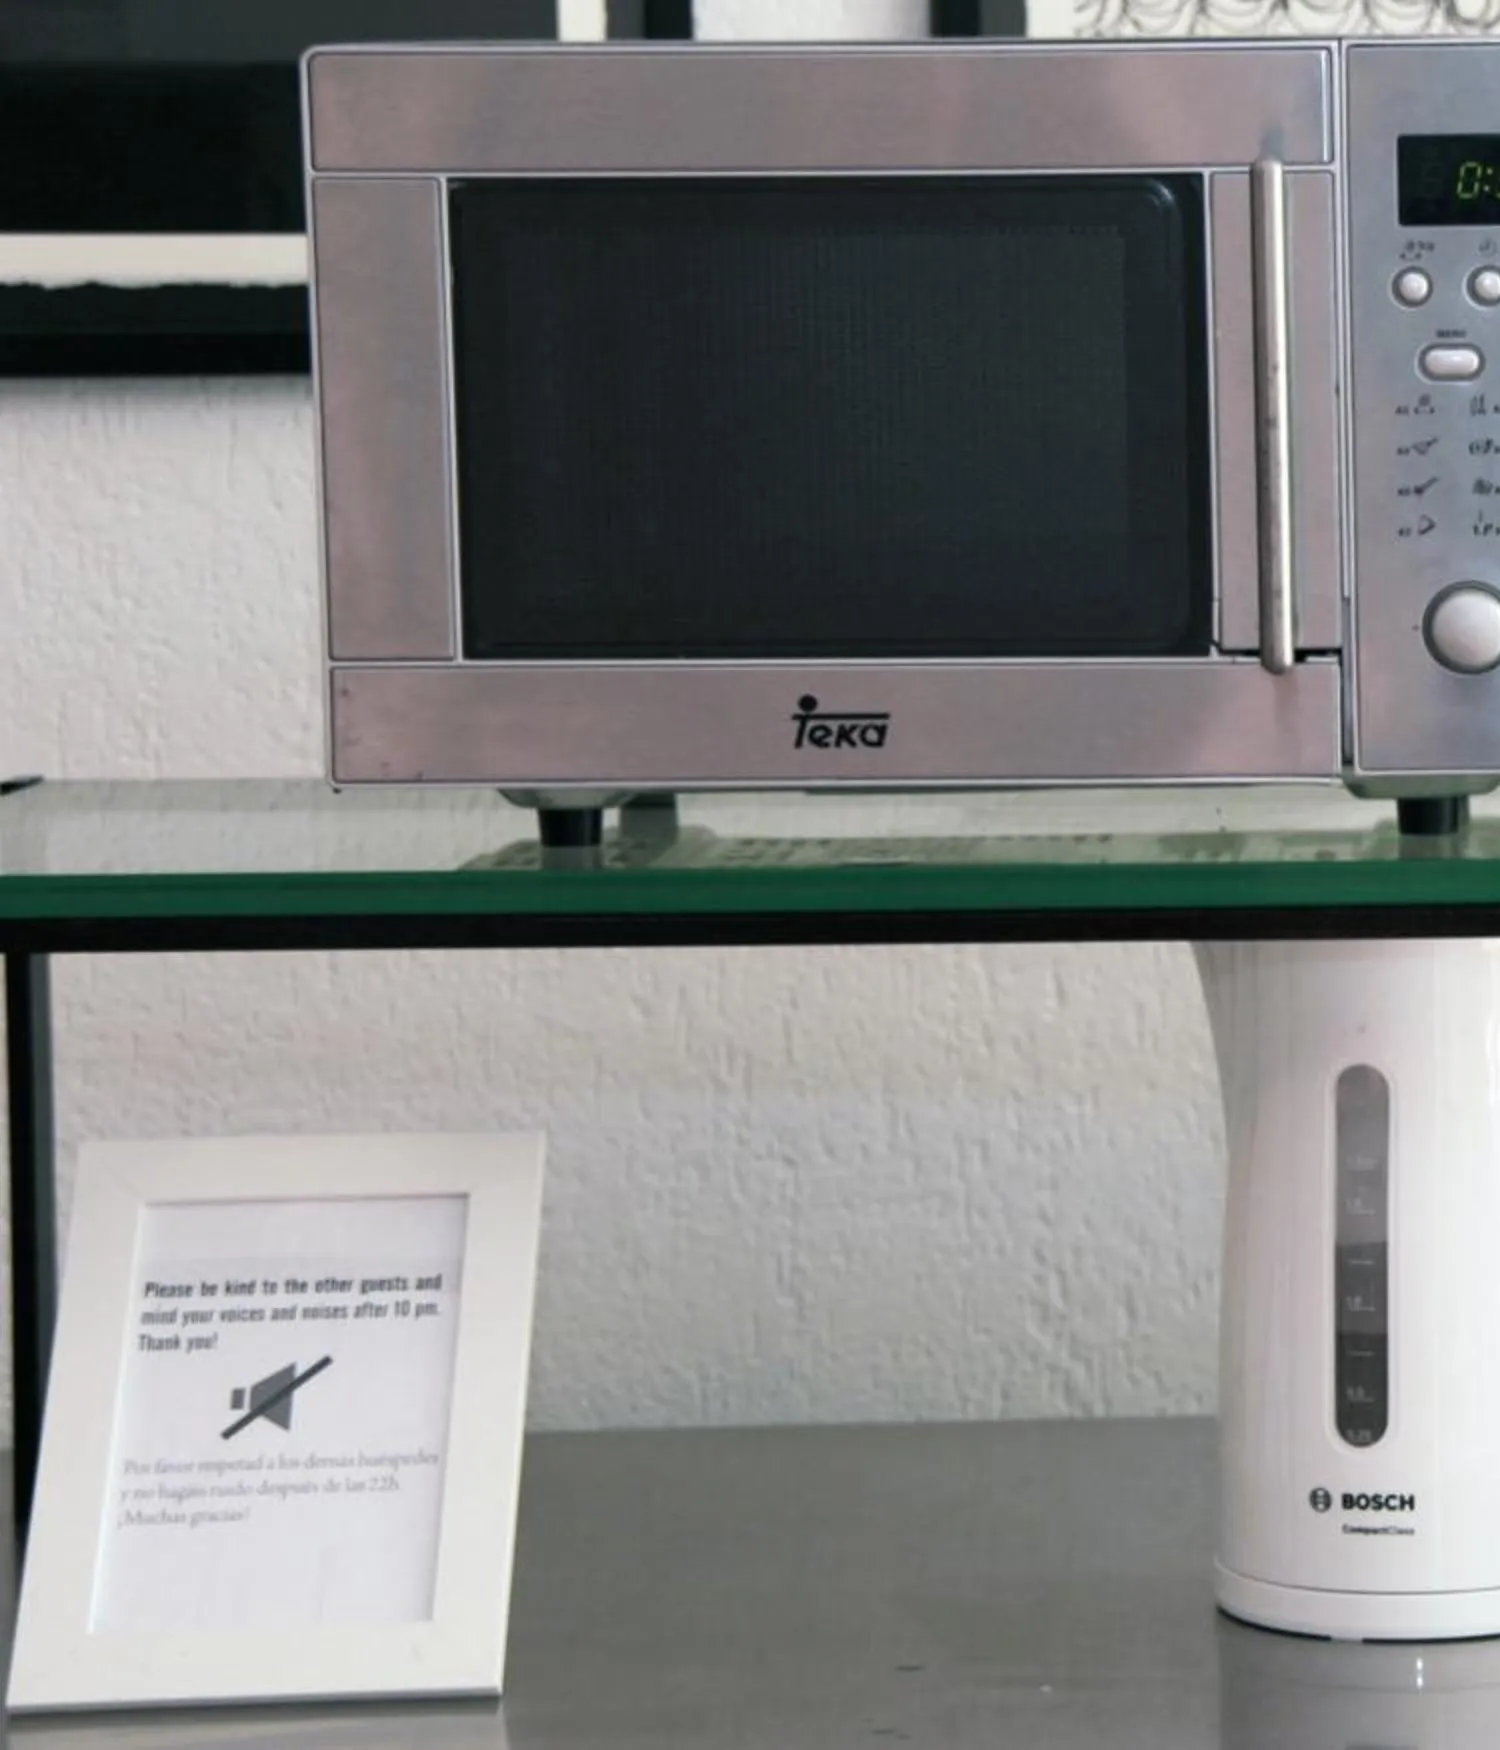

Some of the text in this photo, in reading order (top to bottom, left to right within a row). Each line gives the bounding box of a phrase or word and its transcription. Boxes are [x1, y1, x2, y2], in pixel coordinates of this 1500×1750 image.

[144, 1273, 443, 1298] Please be kind to the other guests and
[140, 1307, 178, 1325] mind
[182, 1308, 215, 1328] your
[220, 1307, 265, 1322] voices
[270, 1304, 297, 1320] and
[302, 1305, 348, 1319] noises
[353, 1302, 389, 1318] after
[394, 1299, 411, 1317] 10
[138, 1332, 219, 1355] Thank you!
[1341, 1492, 1416, 1511] BOSCH
